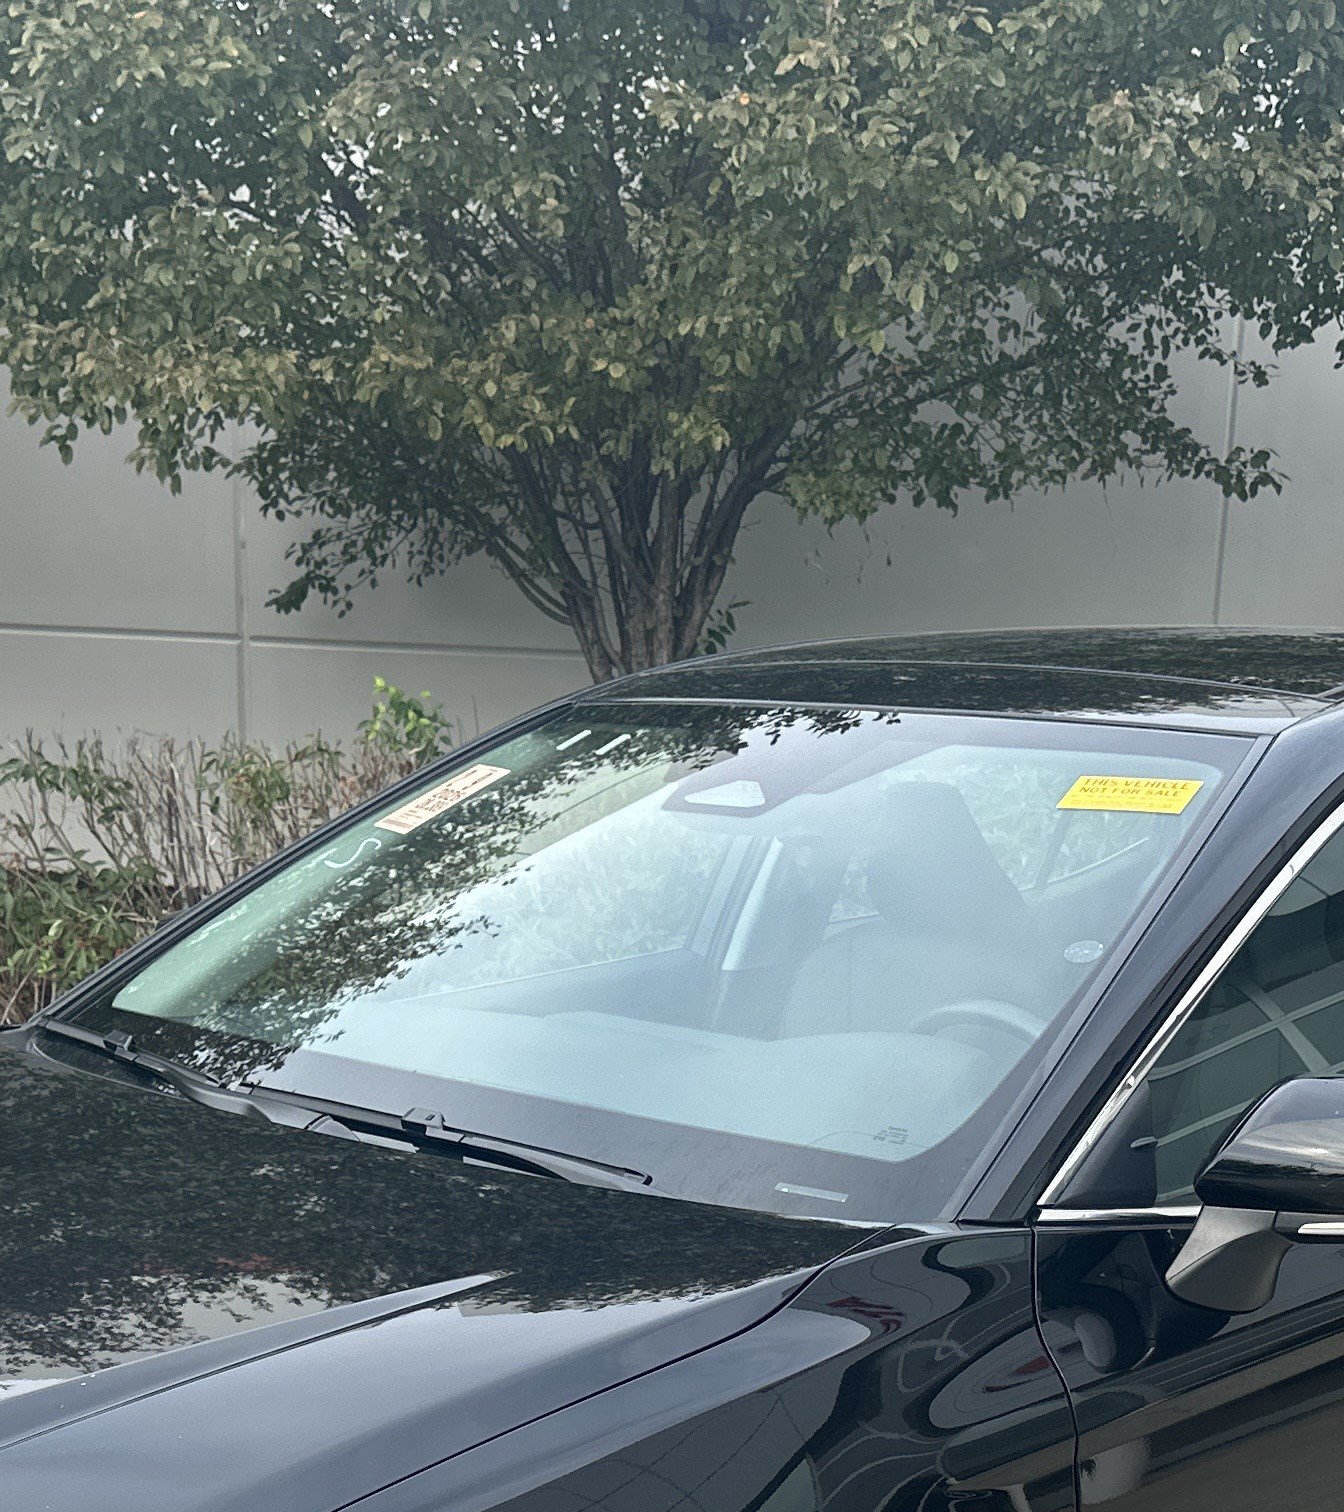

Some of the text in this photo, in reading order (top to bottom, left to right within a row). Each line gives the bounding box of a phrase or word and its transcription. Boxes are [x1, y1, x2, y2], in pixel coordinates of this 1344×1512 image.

[1083, 779, 1190, 790] THIS VEHICLE
[1146, 789, 1182, 797] SALE
